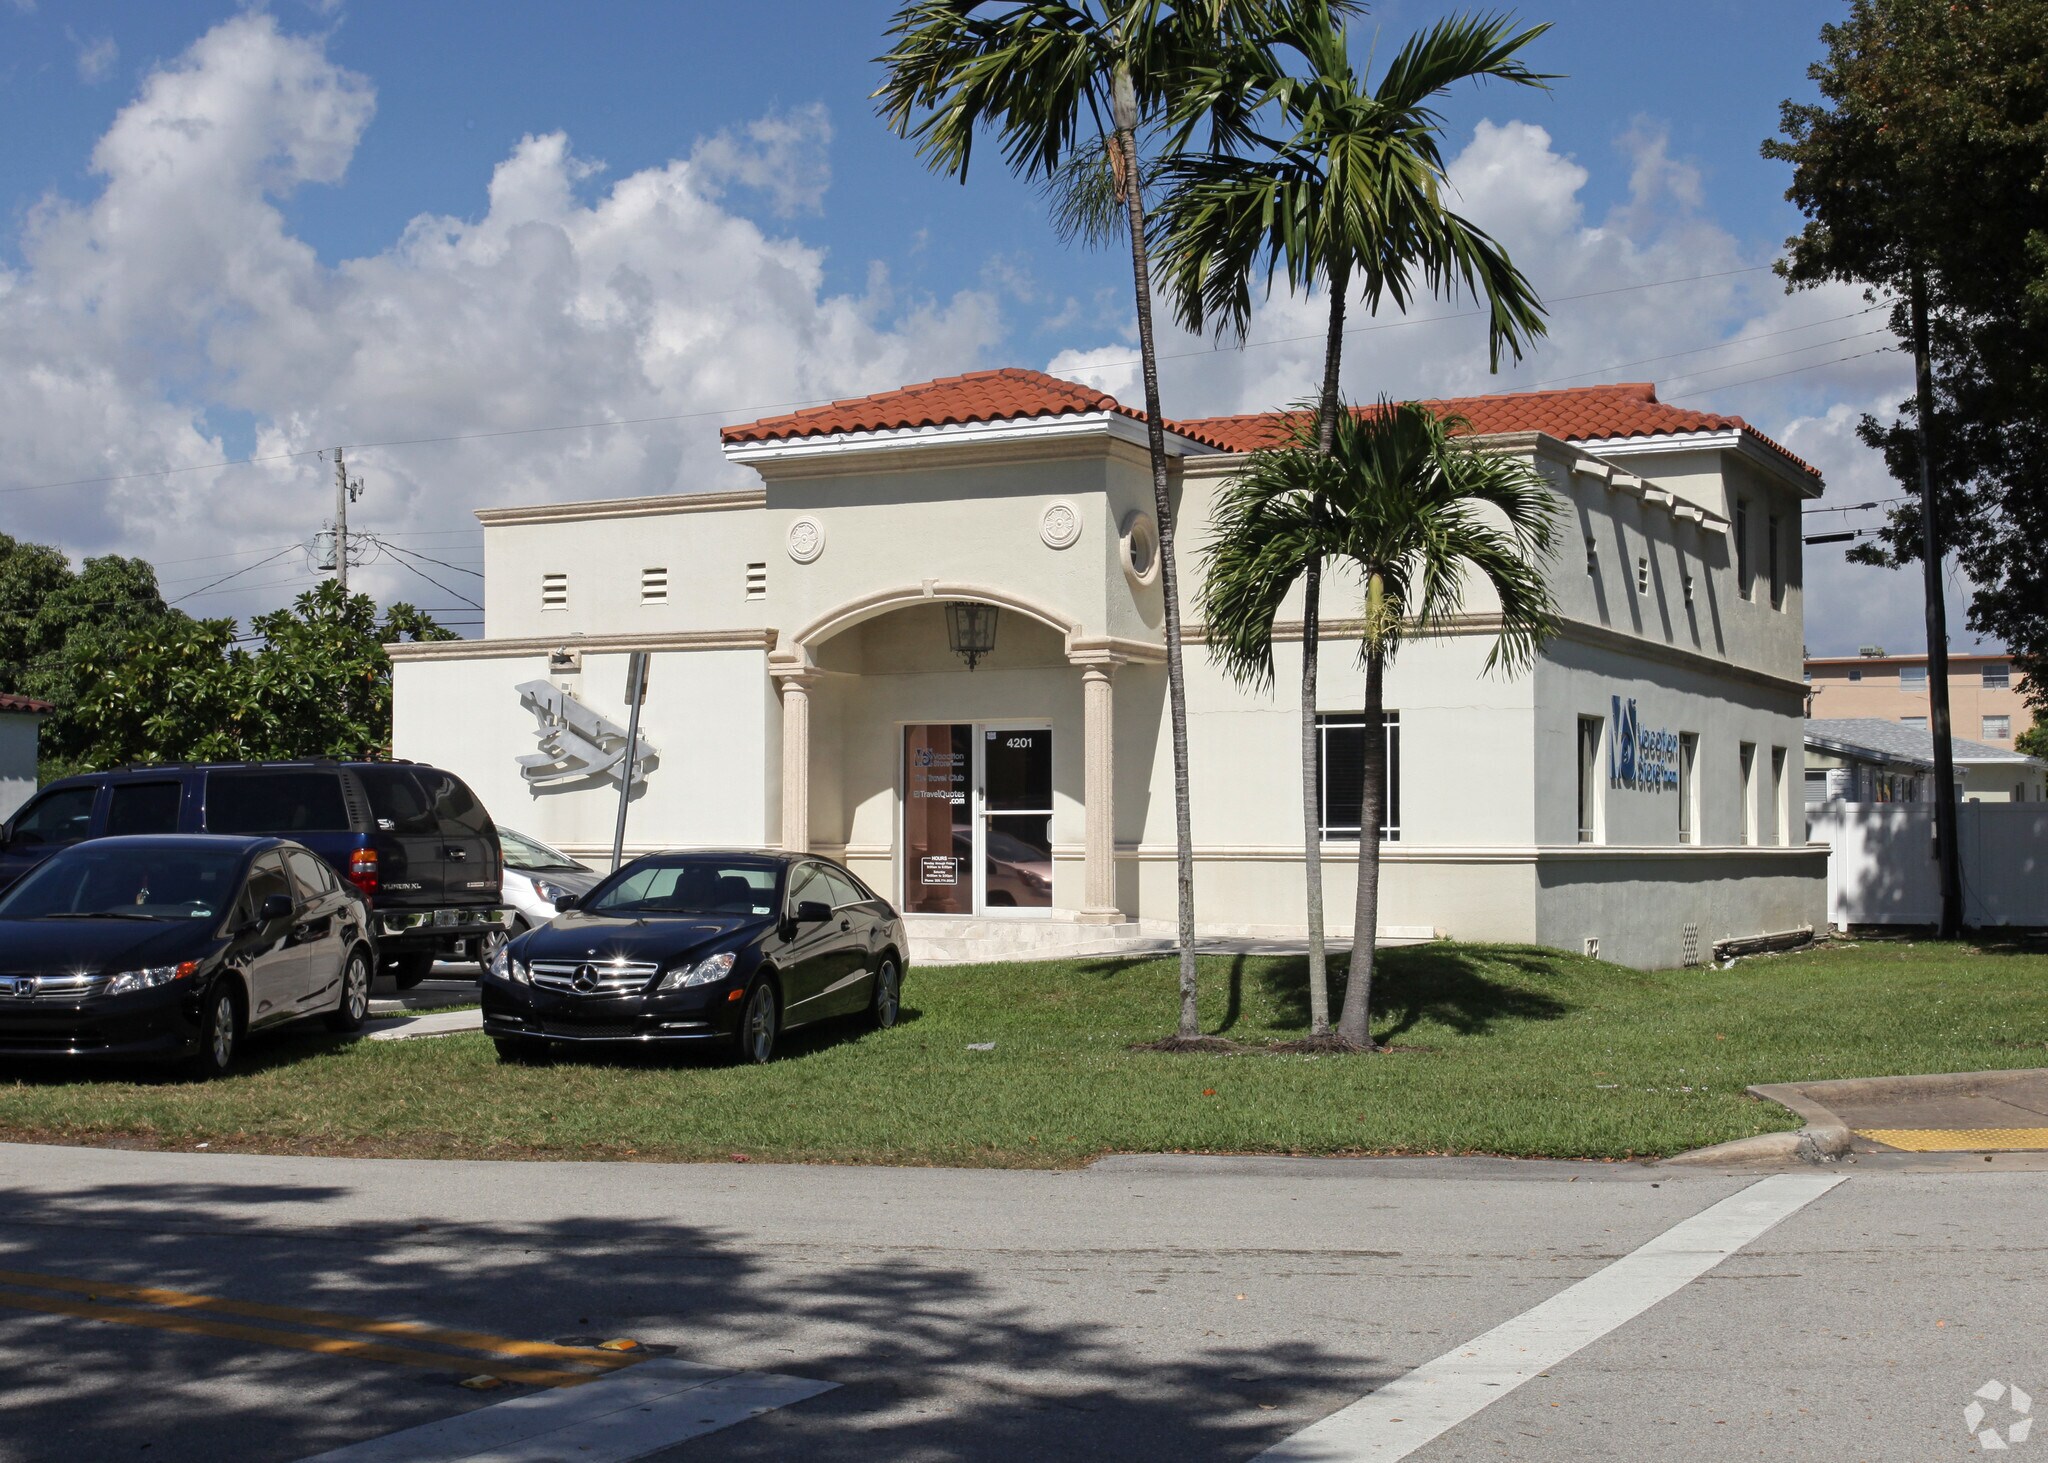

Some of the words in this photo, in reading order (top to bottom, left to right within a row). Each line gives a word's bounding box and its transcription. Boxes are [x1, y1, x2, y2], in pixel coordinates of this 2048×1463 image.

[1006, 737, 1032, 748] 4201
[948, 774, 965, 782] Club
[920, 790, 965, 799] TravelQuotes
